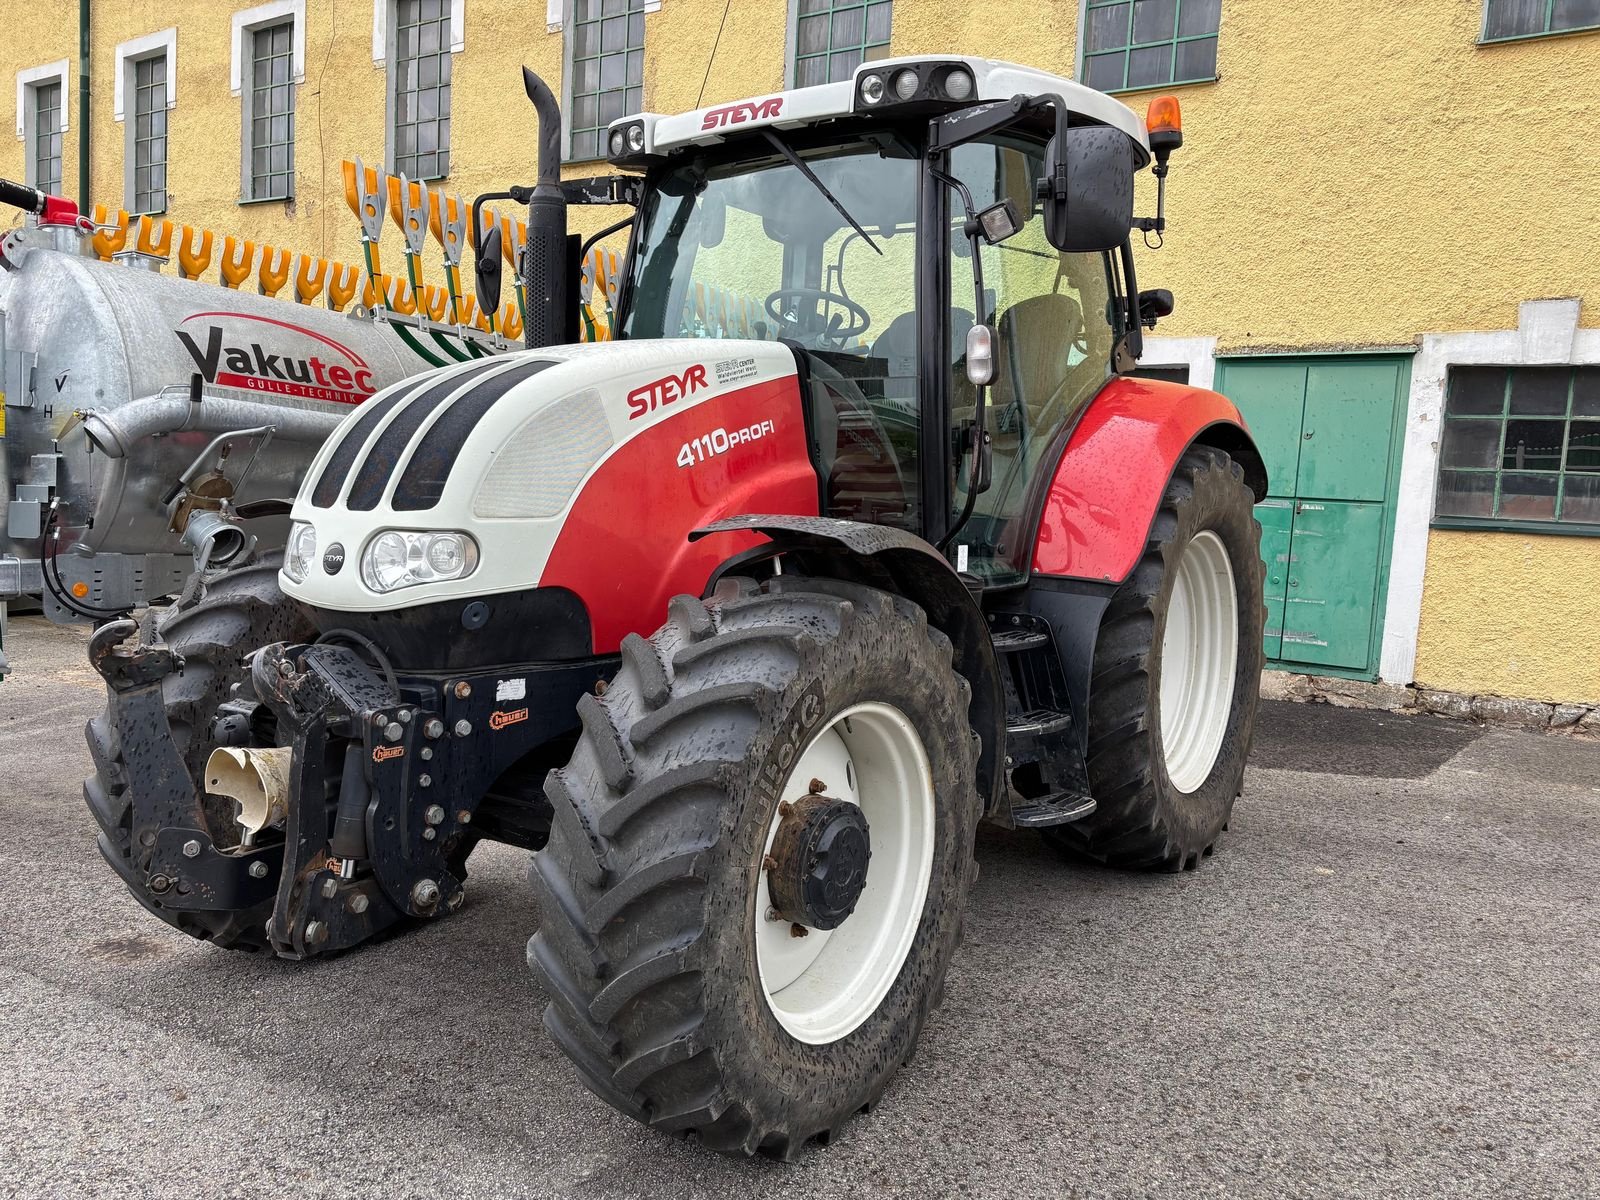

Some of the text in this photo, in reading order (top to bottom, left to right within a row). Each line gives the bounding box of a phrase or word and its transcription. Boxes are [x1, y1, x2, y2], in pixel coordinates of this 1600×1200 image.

[701, 98, 784, 130] STEYR
[174, 326, 378, 394] Vakutec
[739, 358, 755, 367] CENTER
[55, 375, 68, 392] V
[627, 364, 709, 420] STEYR
[44, 404, 53, 418] H
